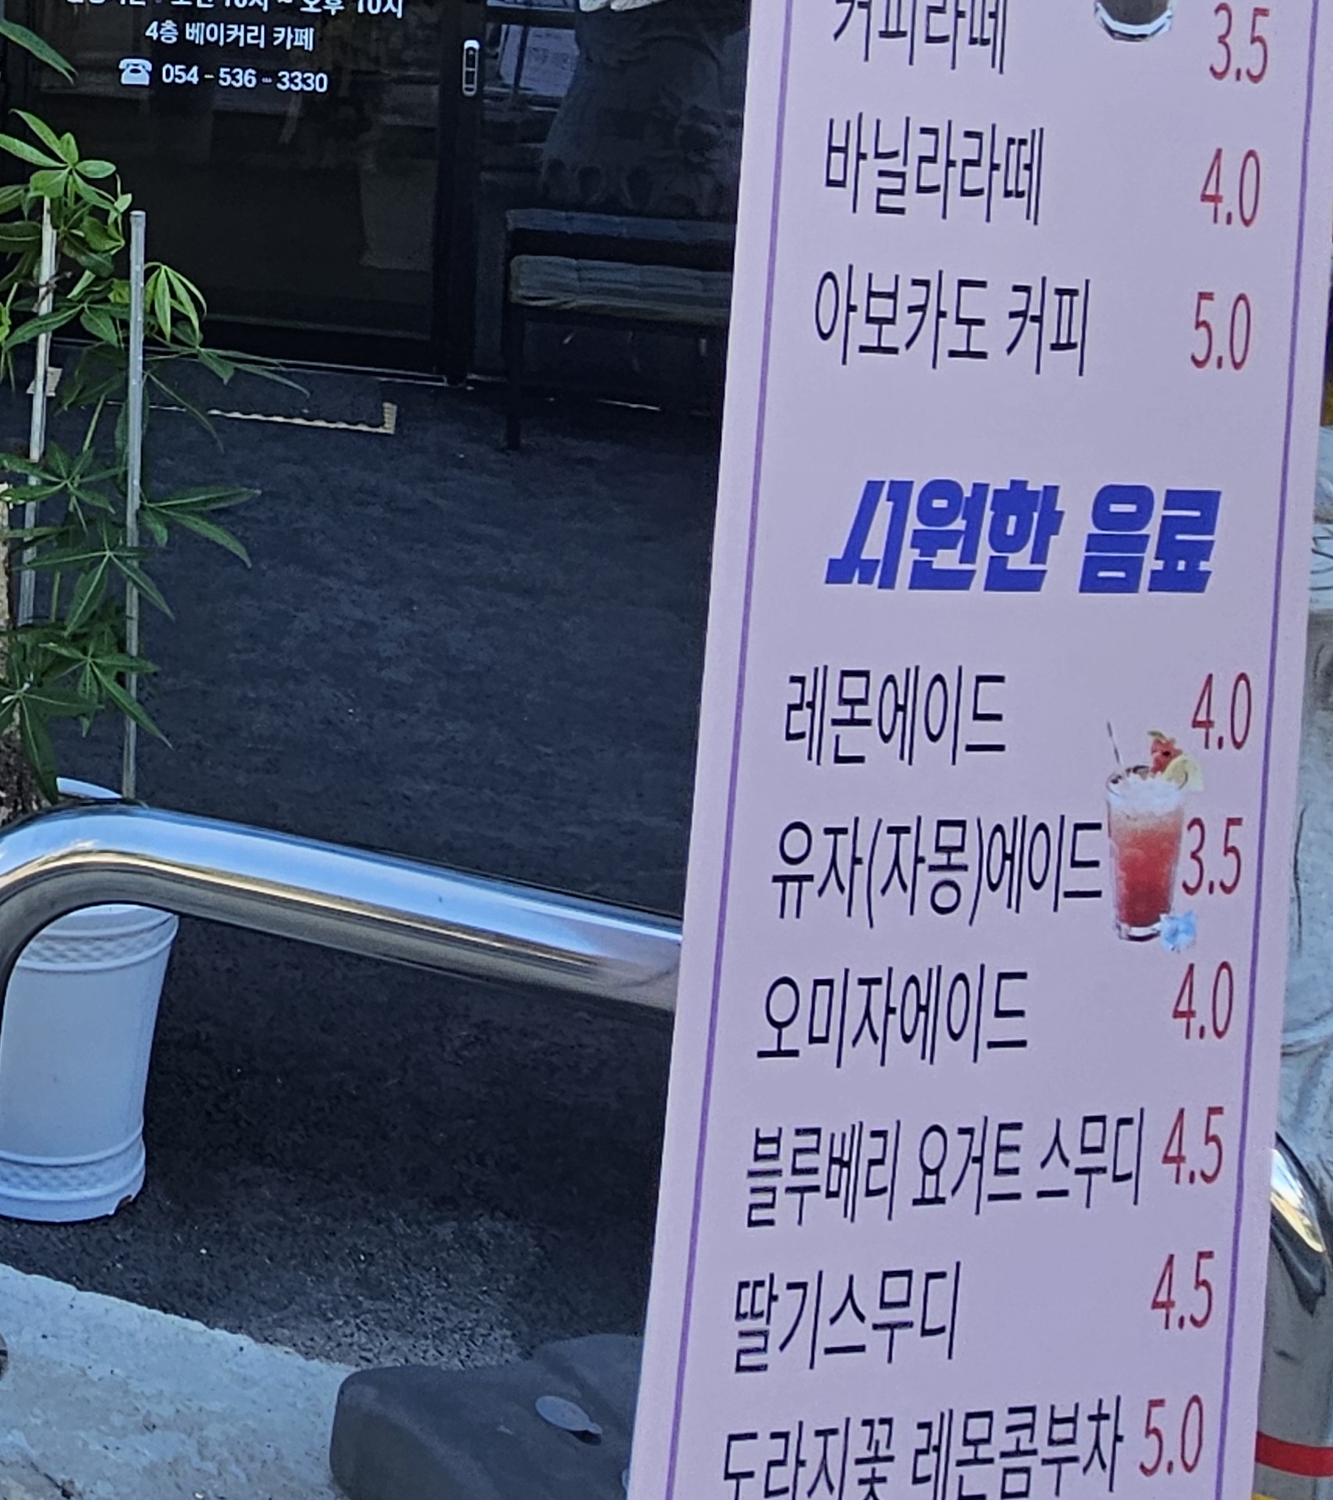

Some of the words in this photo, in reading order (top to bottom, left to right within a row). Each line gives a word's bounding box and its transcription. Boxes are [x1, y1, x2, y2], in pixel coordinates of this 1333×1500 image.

[145, 20, 179, 44] 4층
[185, 21, 266, 49] 베이커리
[272, 26, 315, 52] 카페
[1209, 2, 1271, 83] 3.5
[825, 112, 1044, 226] 바닐라라떼
[1199, 147, 1261, 227] 4.0
[814, 264, 988, 370] 아보카도
[1006, 276, 1090, 377] 커피
[1190, 291, 1252, 371] 5.0
[824, 478, 1065, 592] 시원한
[1078, 483, 1222, 594] 음료
[785, 665, 1006, 766] 레몬에이드
[1191, 672, 1253, 751] 4.0
[771, 814, 1103, 929] 유자(자몽)에이드
[1181, 817, 1244, 897] 3.5
[756, 963, 1028, 1068] 오미자에이드
[1172, 961, 1234, 1040] 4.0
[746, 1119, 901, 1229] 블루베리
[912, 1115, 1024, 1217] 요거트
[1036, 1107, 1145, 1209] 스무디
[1161, 1106, 1225, 1186] 4.5
[734, 1261, 962, 1375] 딸기스무디
[1150, 1250, 1214, 1331] 4.5
[723, 1416, 895, 1500] 도라지꽃
[912, 1395, 1125, 1500] 레몬콤부차
[1139, 1395, 1204, 1478] 5.0
